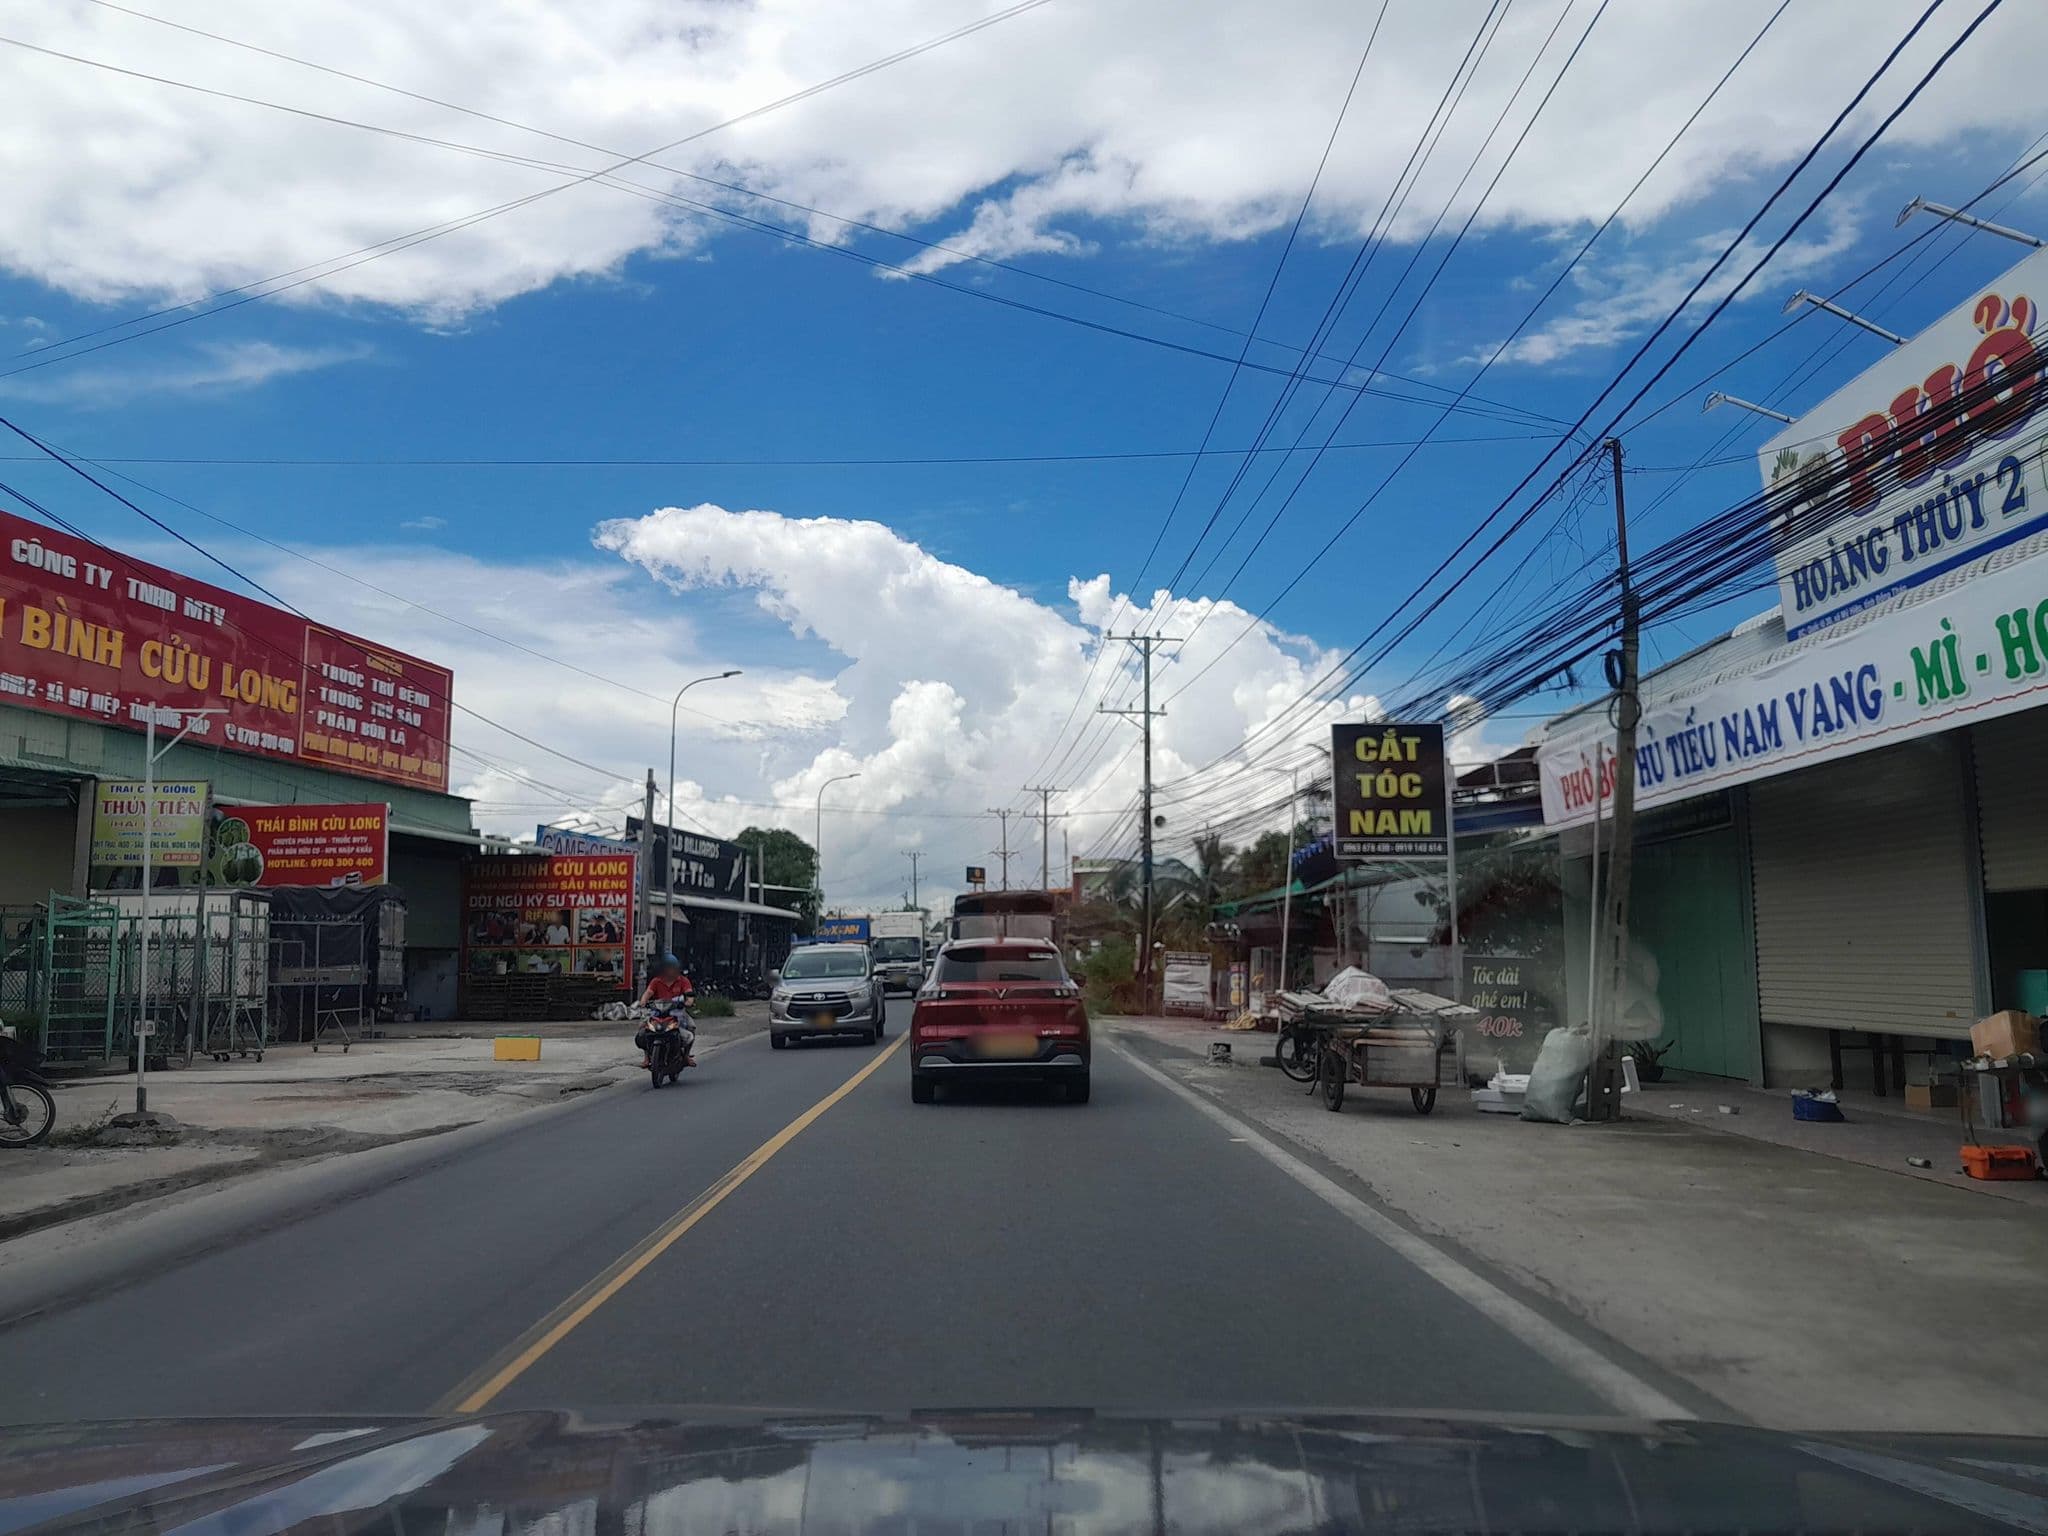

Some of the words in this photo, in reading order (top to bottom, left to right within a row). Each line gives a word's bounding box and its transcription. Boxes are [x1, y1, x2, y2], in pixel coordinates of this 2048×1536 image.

[1791, 527, 1891, 611] HOÀNG
[1997, 455, 2027, 517] 2
[11, 537, 77, 579] CÔNG
[83, 562, 112, 590] TY
[126, 577, 177, 612] TNHH
[183, 596, 226, 626] MTV
[20, 596, 124, 669] BÌNH
[141, 634, 211, 691] CỬU
[221, 662, 297, 714] LONG
[1666, 706, 1717, 778] TIẾU
[1721, 698, 1783, 763] NAM
[1786, 664, 1883, 741] VANG
[1910, 617, 1967, 705] MÌ
[317, 710, 356, 733] PHÂN
[361, 718, 386, 740] BÓN
[1355, 728, 1421, 762] CẮT
[138, 785, 158, 794] CY
[1356, 768, 1422, 798] TÓC
[159, 797, 200, 815] TIÊN
[256, 816, 284, 832] THÁI
[289, 815, 318, 831] BÌNH
[322, 814, 346, 831] CỬU
[350, 817, 380, 830] LONG
[1349, 809, 1431, 835] NAM
[542, 834, 585, 855] GAME
[684, 835, 720, 859] BILLIARDS
[268, 859, 308, 869] HOTLINE:
[356, 857, 374, 866] 400
[553, 858, 583, 876] CỬU
[589, 862, 628, 876] LONG
[590, 879, 627, 890] RIÊNG
[527, 891, 542, 906] KỸ
[547, 894, 566, 907] SƯ
[598, 892, 627, 907] TÂM
[1473, 966, 1494, 985] Tóc
[1496, 966, 1520, 985] dài
[1472, 990, 1498, 1010] ghé
[1477, 1016, 1523, 1038] 40k
